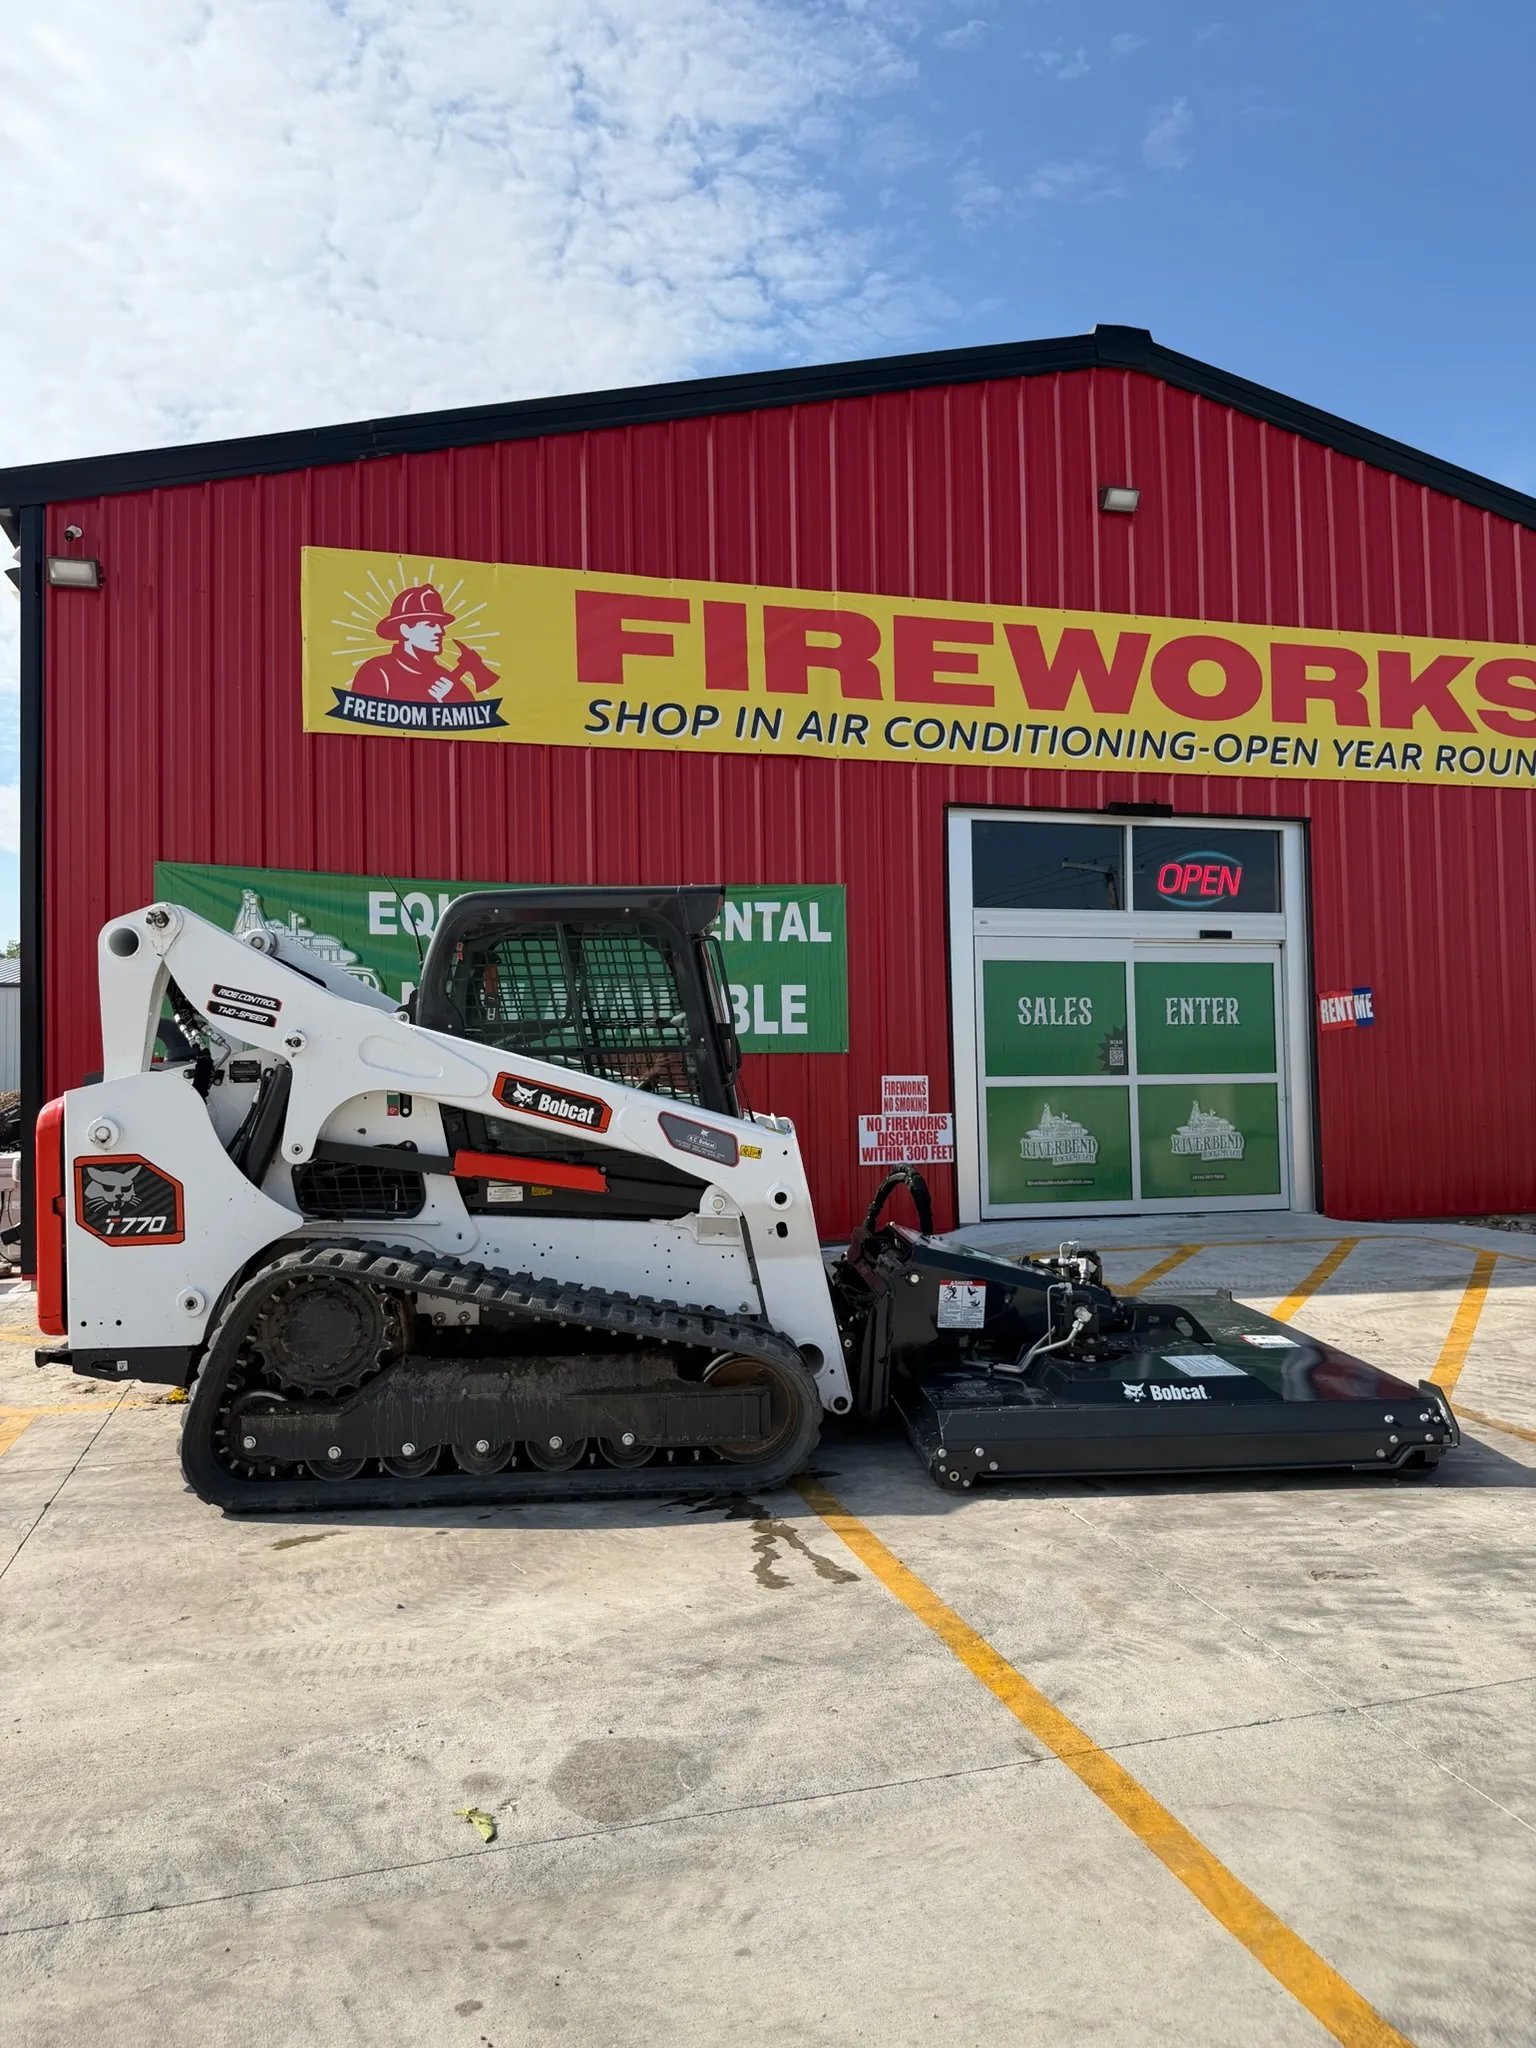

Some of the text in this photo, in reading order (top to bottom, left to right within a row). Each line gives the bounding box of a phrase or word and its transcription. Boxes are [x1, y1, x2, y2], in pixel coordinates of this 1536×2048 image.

[574, 589, 1536, 738] FIREWORKS
[342, 695, 491, 727] FREEDOM FAMILY
[584, 699, 721, 738] SHOP
[735, 705, 784, 742] IN
[796, 709, 870, 747] AIR
[1332, 738, 1423, 773] YEAR
[1157, 863, 1242, 896] OPEN
[218, 988, 277, 1009] RIDE CONTROL
[218, 1005, 268, 1023] TWO-SPEED
[1017, 996, 1093, 1026] SALES
[1165, 997, 1240, 1026] ENTER
[1320, 993, 1374, 1024] RENT ME
[884, 1081, 927, 1096] FIREWORKS
[538, 1093, 595, 1124] Bobcat
[884, 1097, 927, 1112] NO SMOKING
[866, 1115, 948, 1132] NO FIREWORKS
[877, 1131, 939, 1147] DISCHARGE
[1022, 1138, 1097, 1157] RIVERBEND
[1172, 1134, 1244, 1152] RIVERBEND
[861, 1145, 954, 1162] WITHIN 300 FEET
[106, 1216, 167, 1235] T770
[1150, 1384, 1208, 1401] Bobcat
